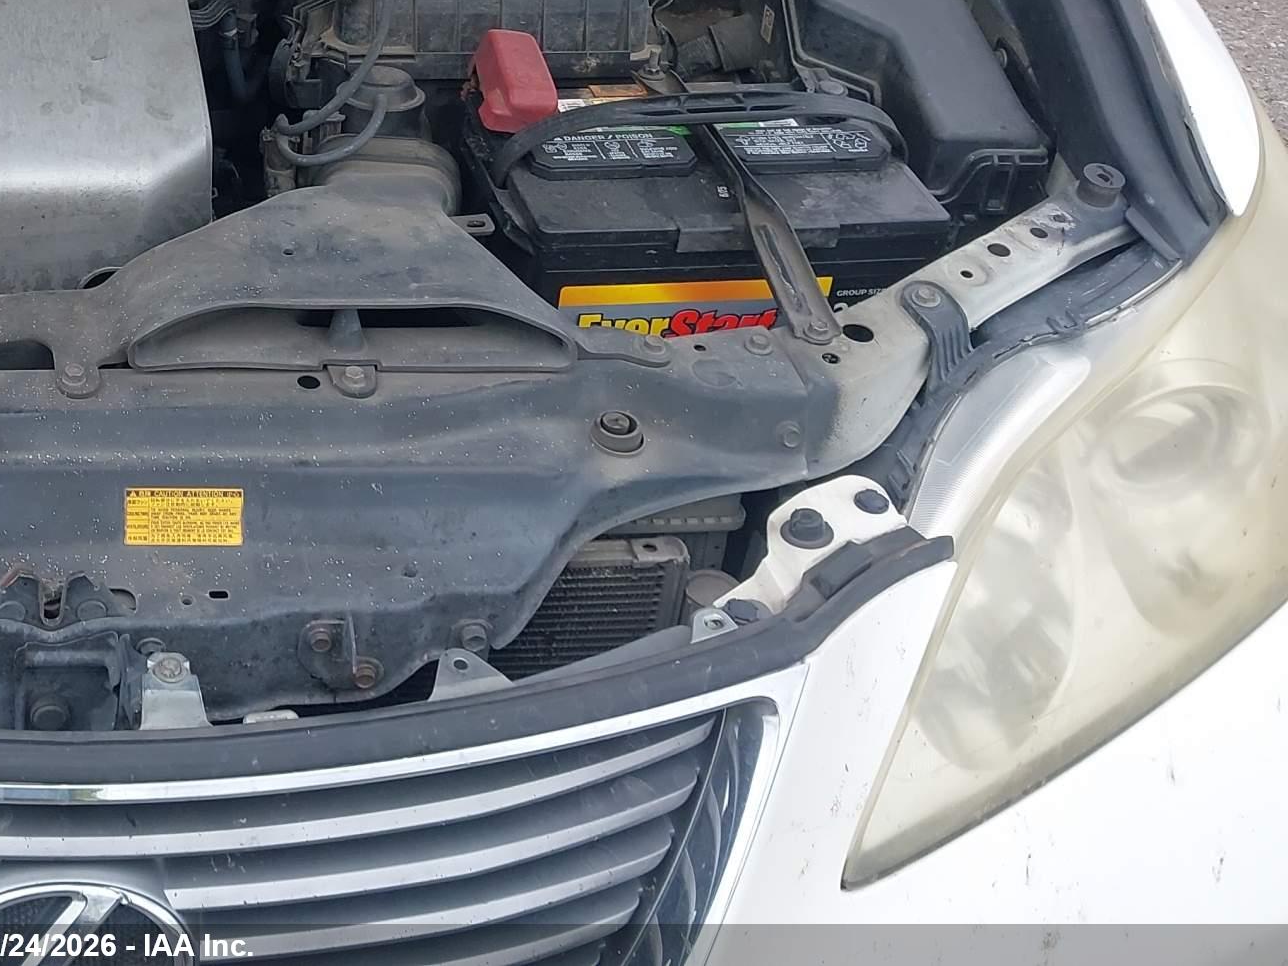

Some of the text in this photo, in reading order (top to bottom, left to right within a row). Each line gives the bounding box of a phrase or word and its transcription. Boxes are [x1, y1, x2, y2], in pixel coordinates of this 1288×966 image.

[615, 132, 654, 140] POISON
[836, 288, 867, 297] GROUP
[154, 490, 183, 498] CAUTION
[186, 490, 223, 498] ATTENTION
